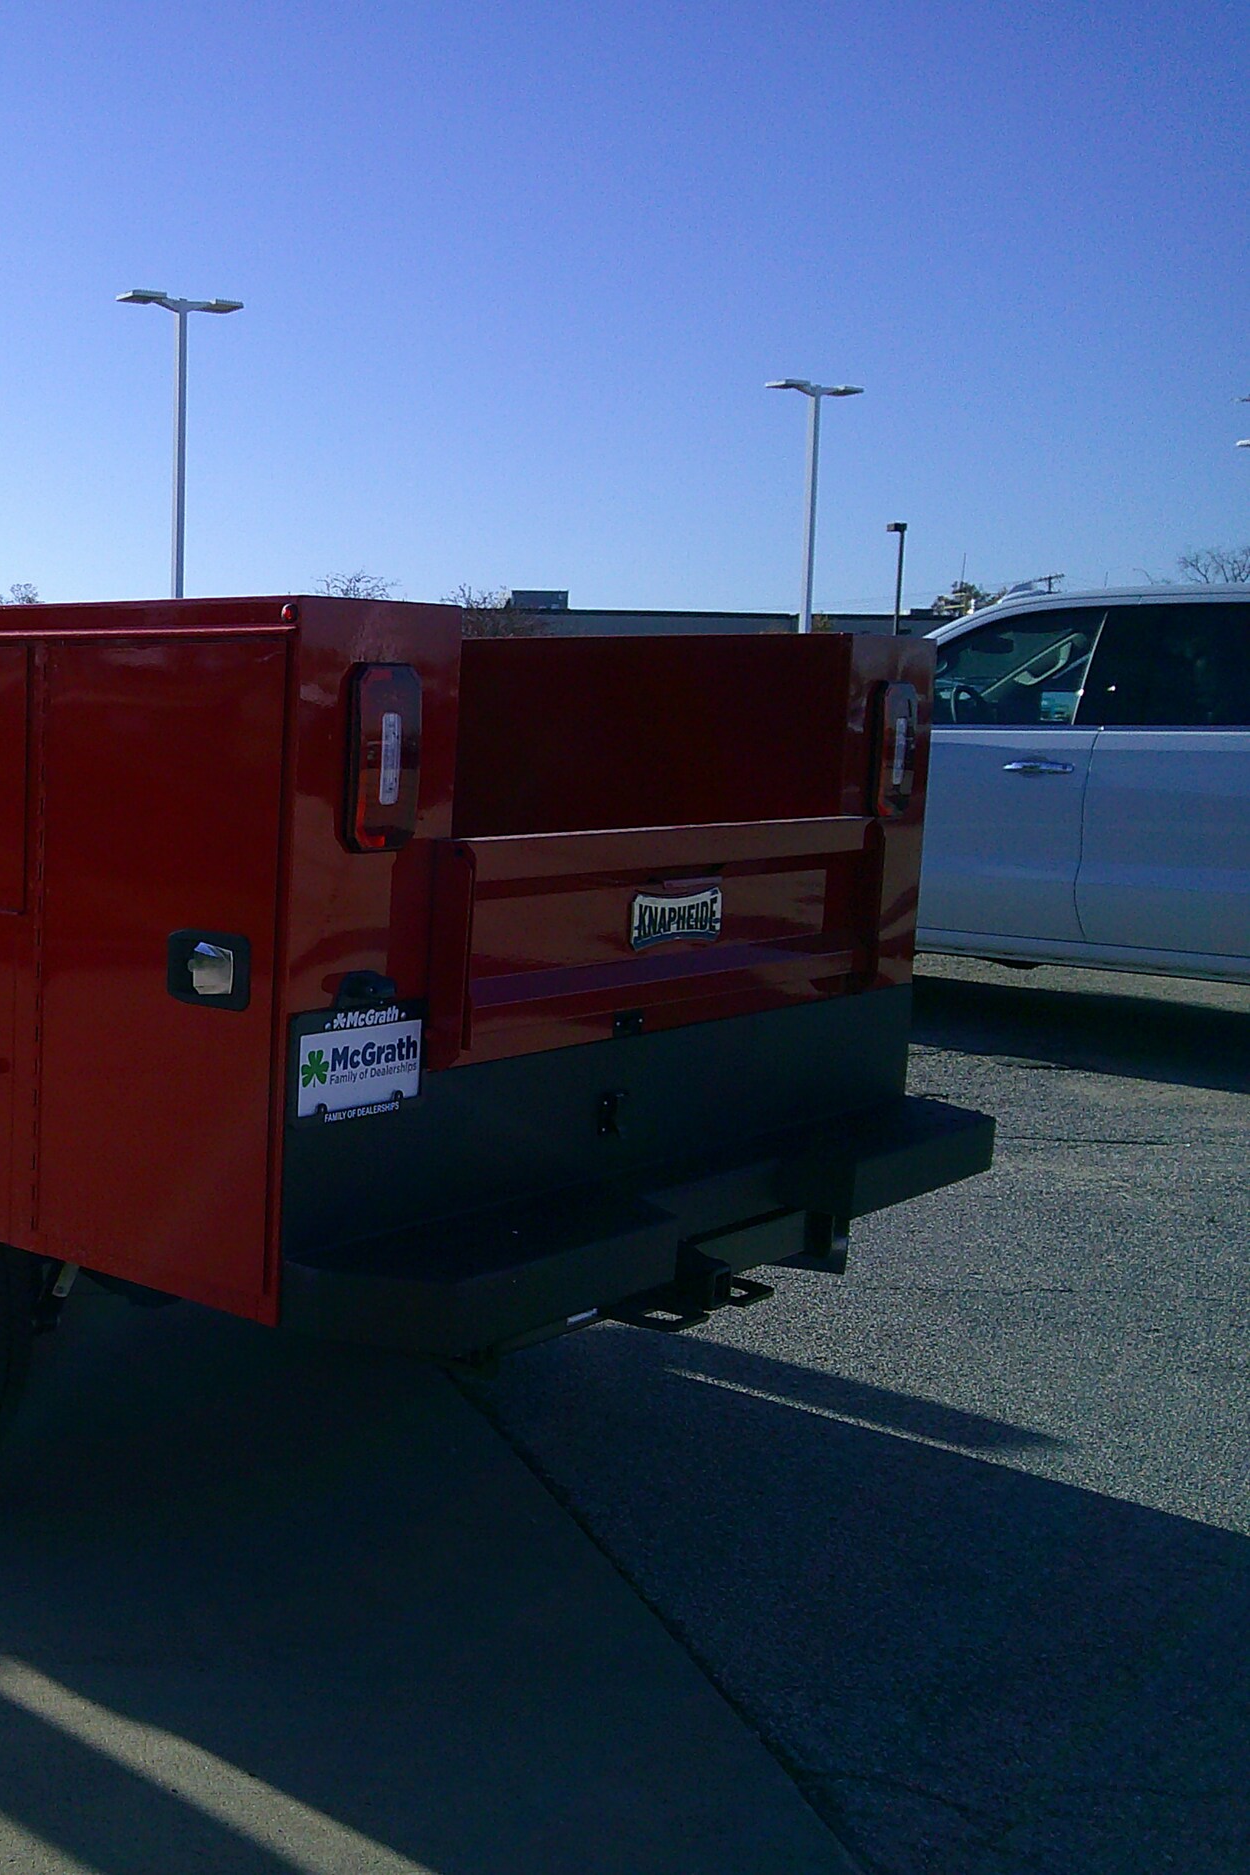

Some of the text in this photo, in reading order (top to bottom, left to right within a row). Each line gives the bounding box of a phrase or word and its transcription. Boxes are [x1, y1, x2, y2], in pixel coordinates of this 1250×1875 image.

[637, 896, 718, 939] KNAPHEIDE
[346, 1005, 399, 1028] McGrath
[330, 1035, 418, 1072] McGrath
[329, 1061, 417, 1086] Family of Dealerships
[324, 1101, 400, 1123] FAMILY OF DEALERSHIPS
